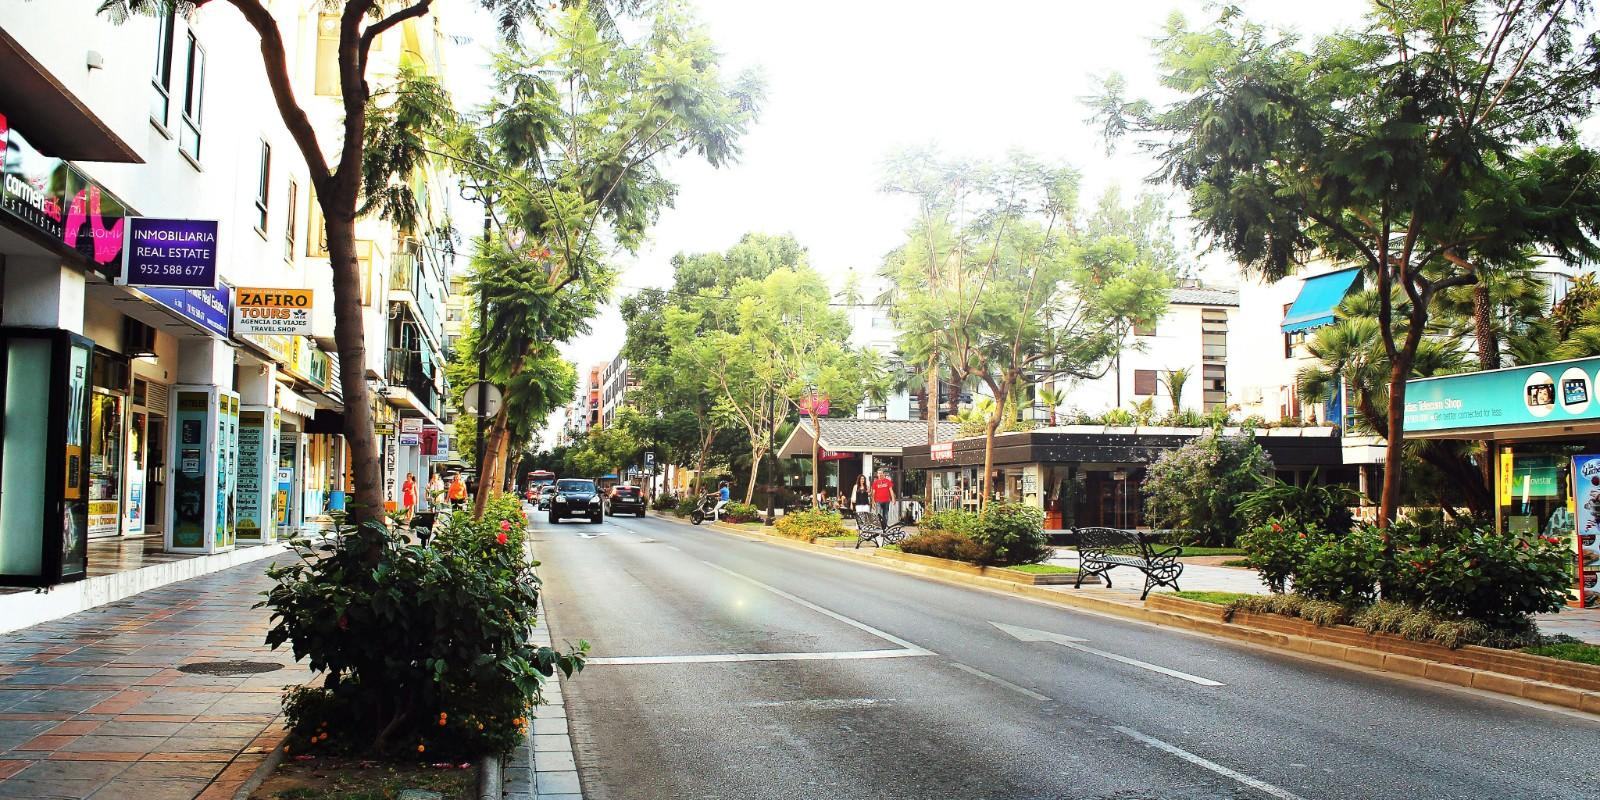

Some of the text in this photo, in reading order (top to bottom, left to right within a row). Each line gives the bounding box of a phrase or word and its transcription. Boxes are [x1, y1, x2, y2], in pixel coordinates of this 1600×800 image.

[5, 173, 45, 212] carmen
[4, 196, 61, 238] ESTILISTAS
[134, 229, 215, 242] INMOBILIARIA
[137, 247, 210, 260] REAL ESTATE
[140, 264, 205, 276] 952 588 677
[240, 294, 308, 307] ZAFIRO
[240, 307, 291, 320] TOURS
[1444, 398, 1462, 409] Shop
[1443, 412, 1457, 420] better
[1458, 409, 1483, 419] connected
[1491, 408, 1503, 417] less
[647, 454, 654, 462] P
[1530, 476, 1551, 485] ovistar
